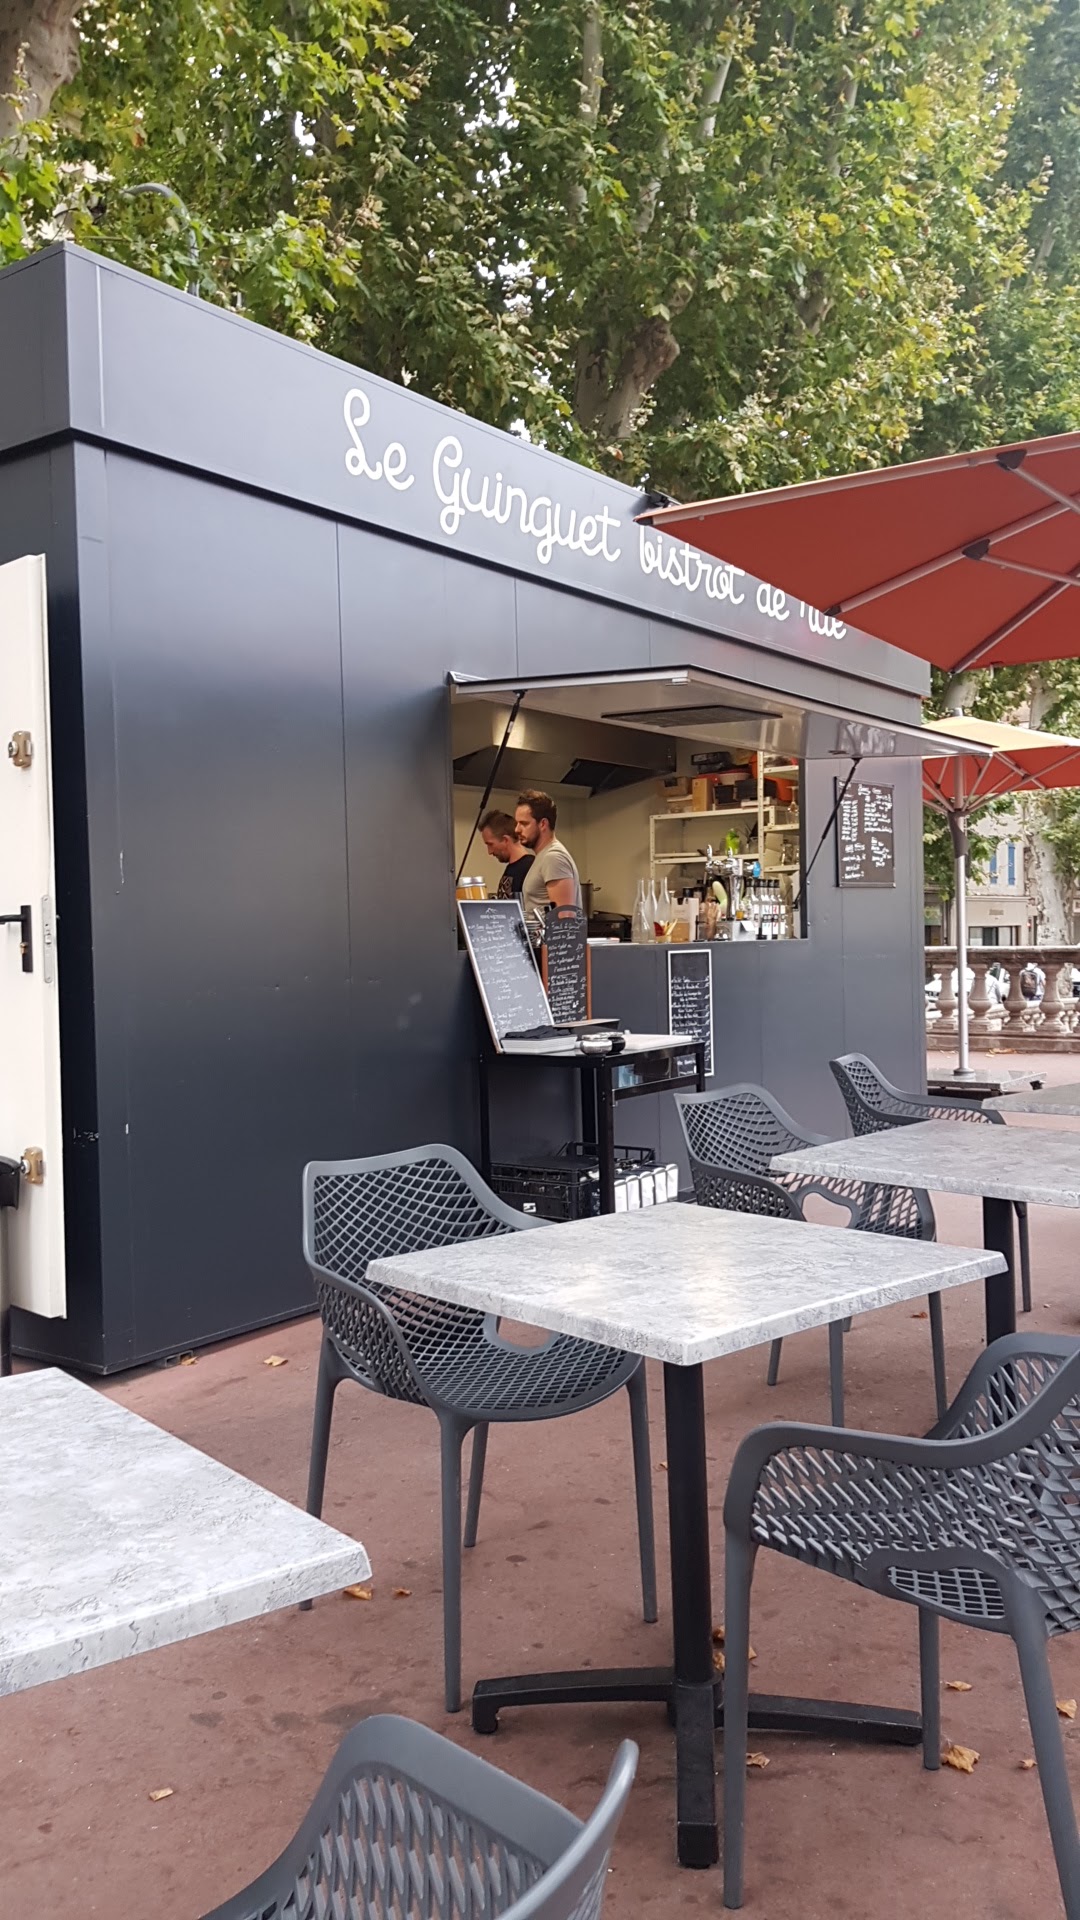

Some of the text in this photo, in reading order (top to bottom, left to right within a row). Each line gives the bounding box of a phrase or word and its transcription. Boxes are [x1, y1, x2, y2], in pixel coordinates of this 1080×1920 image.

[344, 388, 414, 491] Le
[432, 435, 622, 565] Guinguet
[639, 525, 746, 605] bistrot
